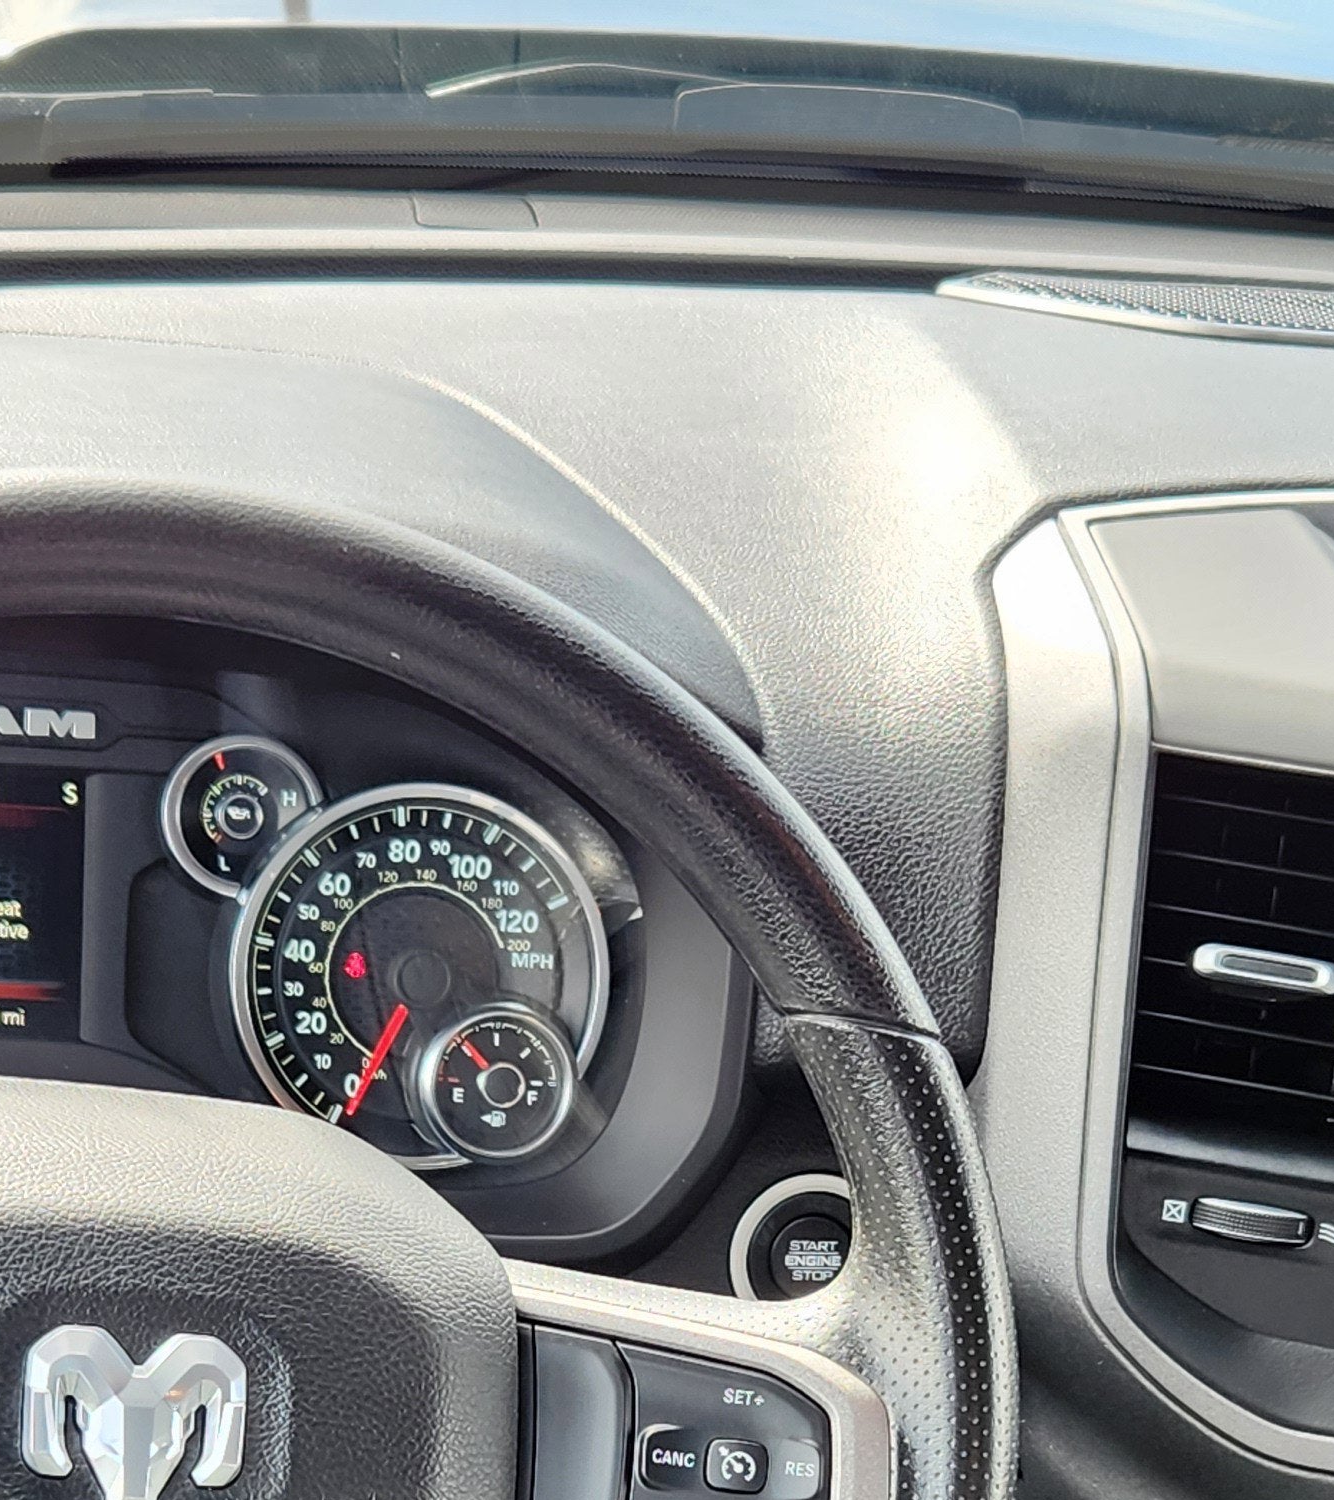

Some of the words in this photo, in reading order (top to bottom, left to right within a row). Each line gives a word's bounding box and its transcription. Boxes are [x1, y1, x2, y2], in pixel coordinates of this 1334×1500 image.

[62, 783, 78, 805] S
[281, 790, 297, 807] H
[388, 840, 421, 863] 80
[430, 840, 450, 856] 90
[218, 855, 230, 872] L
[356, 852, 376, 869] 70
[449, 855, 492, 880] 100
[378, 871, 398, 884] 120
[416, 869, 437, 882] 140
[318, 873, 351, 897] 60
[457, 880, 478, 893] 160
[493, 880, 519, 896] 110
[297, 904, 319, 921] 50
[334, 898, 353, 911] 100
[481, 898, 502, 911] 180
[320, 919, 335, 932] 80
[496, 910, 538, 933] 120
[284, 939, 315, 962] 40
[507, 940, 530, 952] 200
[308, 962, 323, 974] 60
[511, 951, 553, 970] MPH
[283, 981, 303, 997] 30
[312, 996, 326, 1008] 40
[3, 1007, 25, 1026] mi
[296, 1012, 327, 1035] 20
[330, 1033, 344, 1045] 20
[314, 1054, 331, 1070] 10
[344, 1073, 361, 1098] 0
[452, 1087, 465, 1103] E
[527, 1090, 539, 1106] F
[789, 1240, 838, 1253] START
[784, 1254, 841, 1267] ENGINE
[791, 1269, 834, 1282] STOP
[652, 1447, 696, 1468] CANC
[785, 1461, 815, 1477] RES
